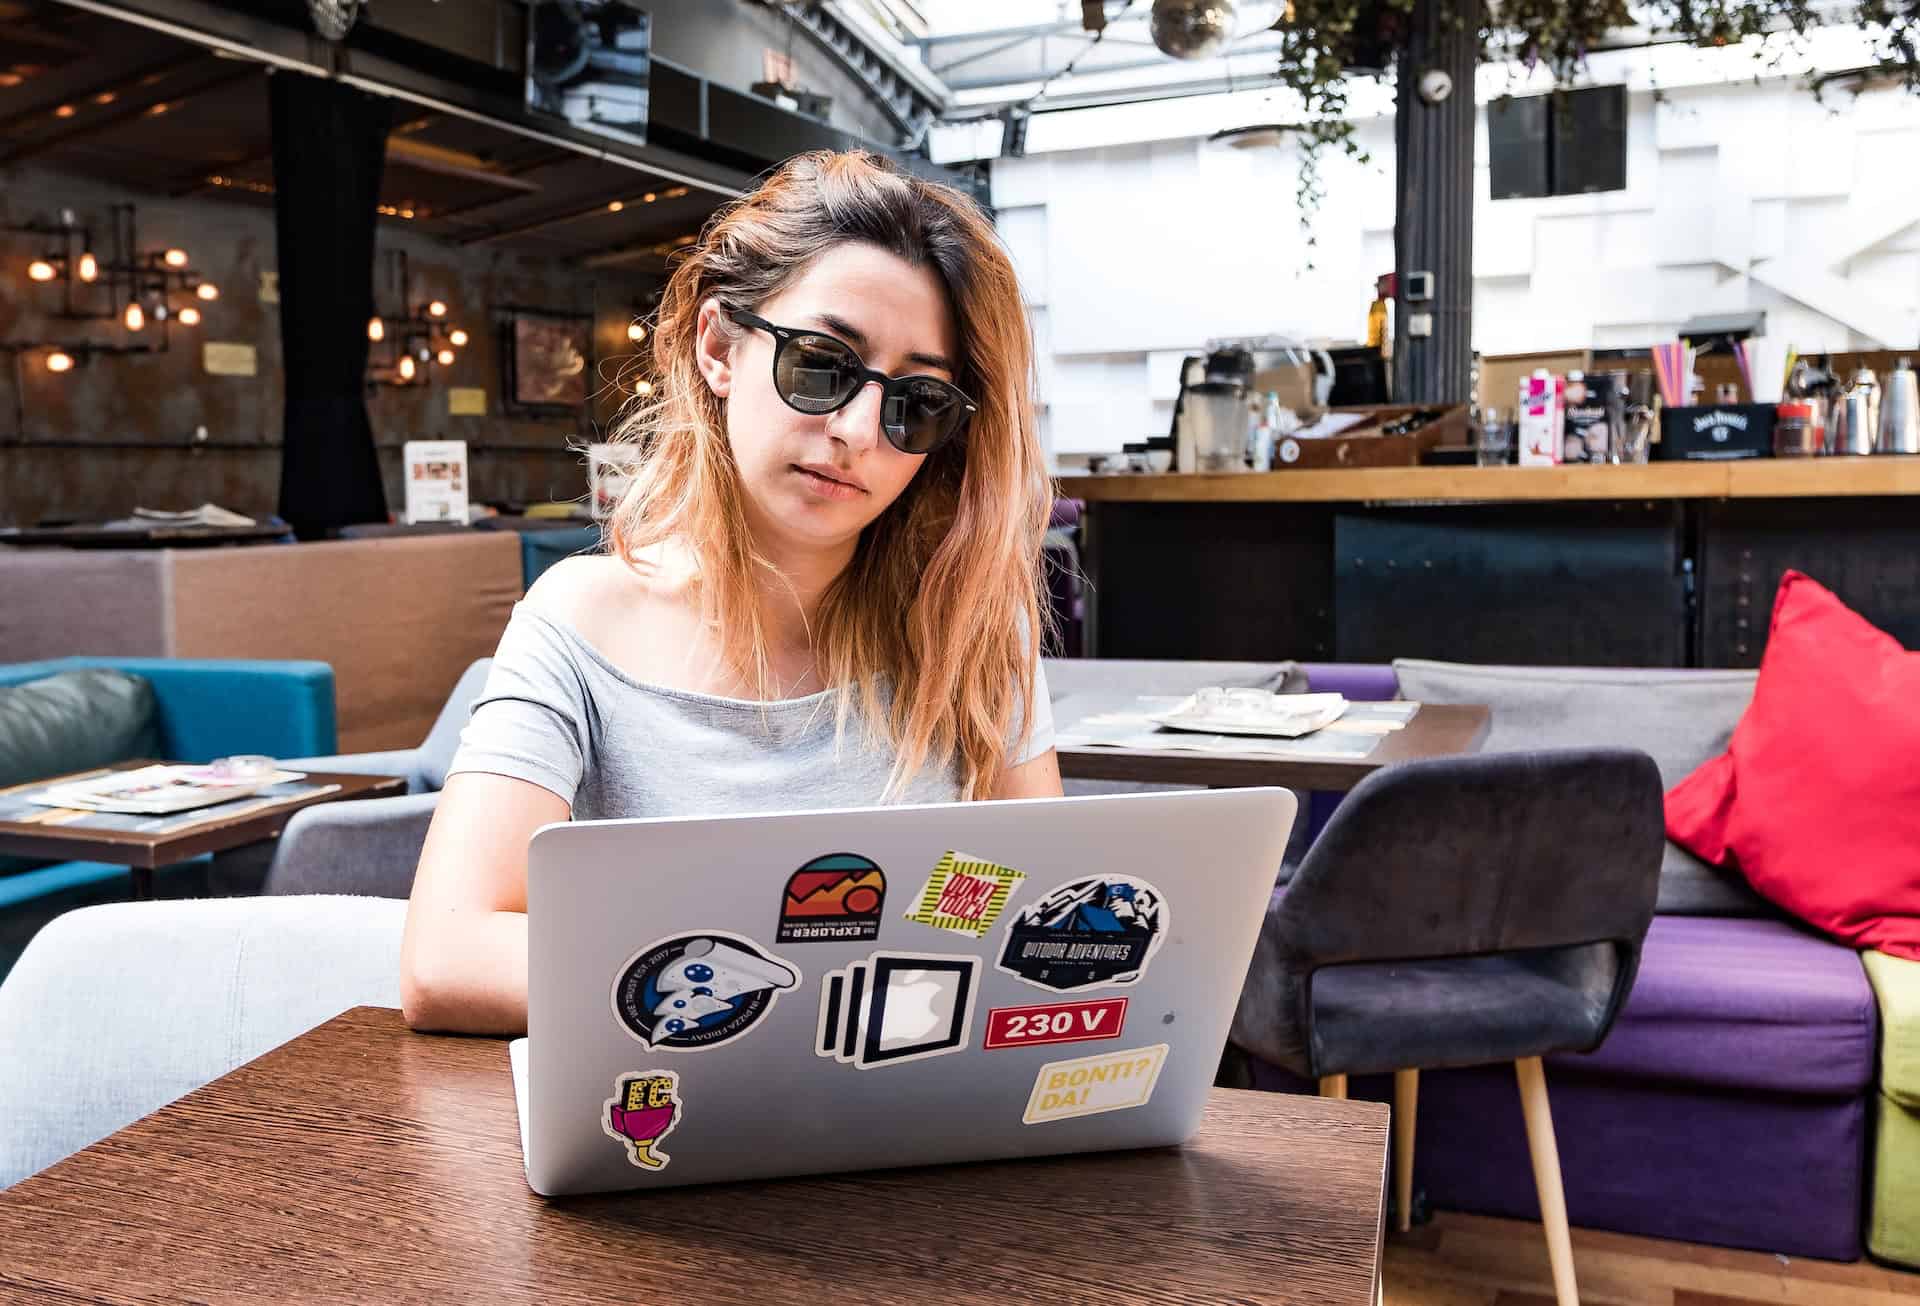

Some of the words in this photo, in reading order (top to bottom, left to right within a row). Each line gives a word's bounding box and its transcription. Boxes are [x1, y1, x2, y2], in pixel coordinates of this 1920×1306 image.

[934, 892, 988, 921] TOUCH
[793, 927, 861, 937] EXPLORER
[1021, 942, 1066, 960] OUTDOOR
[1066, 943, 1132, 961] ADVENTURES
[625, 979, 638, 1004] TRUST
[648, 949, 670, 965] 2017
[728, 1010, 753, 1029] PIZZA
[1005, 1012, 1073, 1038] 230
[1081, 1008, 1108, 1031] V
[690, 1026, 728, 1041] FRIDAY
[1040, 1088, 1091, 1111] DA!
